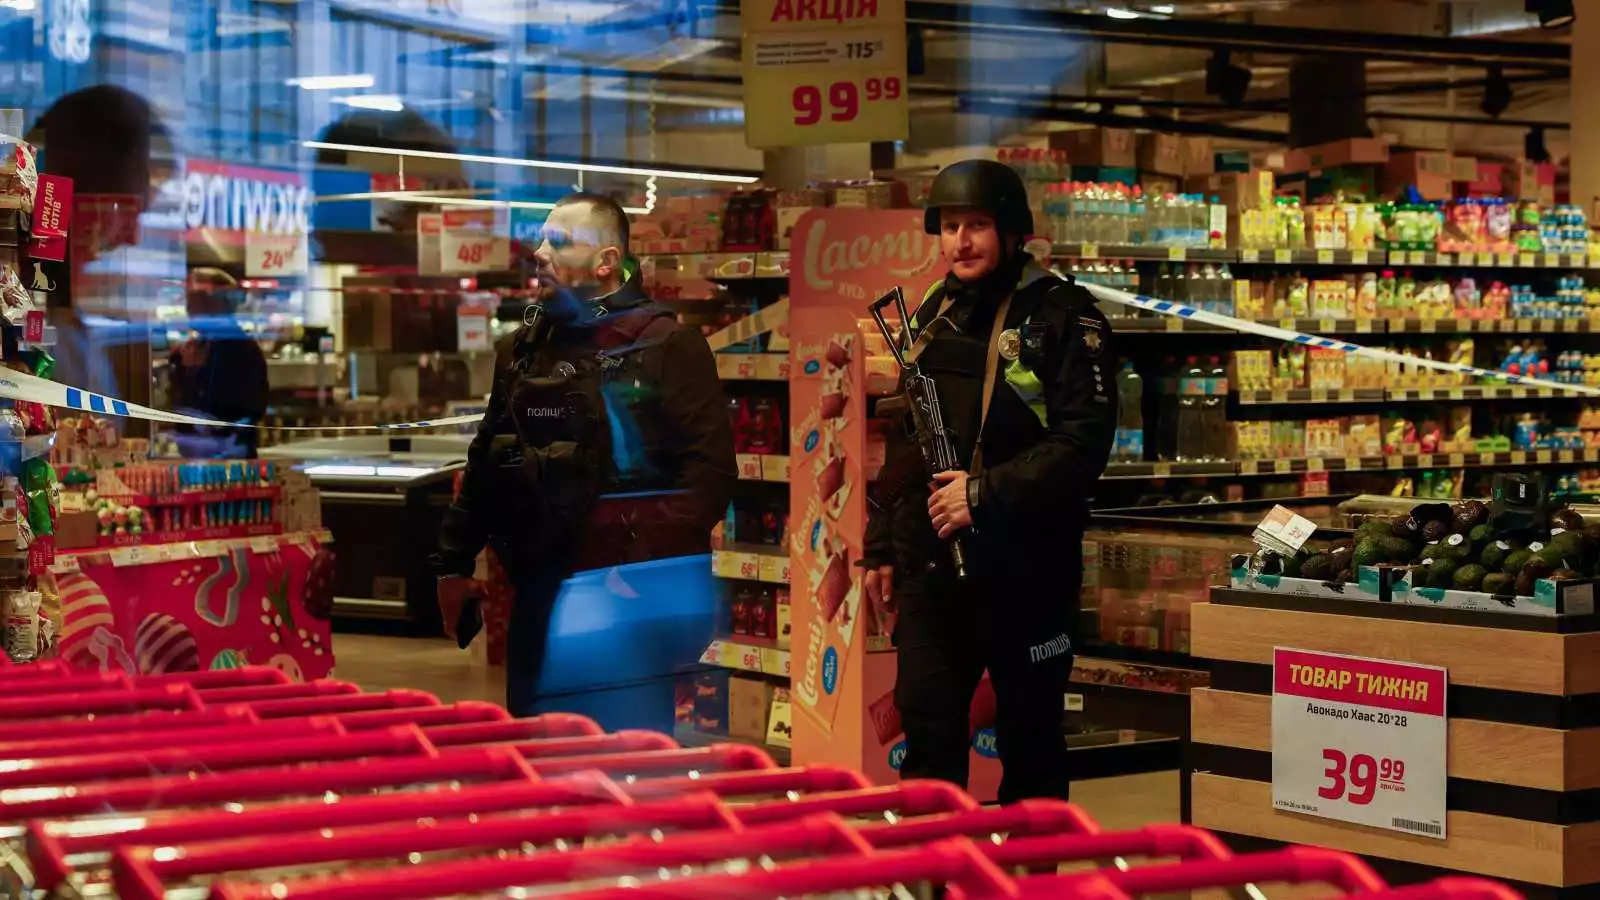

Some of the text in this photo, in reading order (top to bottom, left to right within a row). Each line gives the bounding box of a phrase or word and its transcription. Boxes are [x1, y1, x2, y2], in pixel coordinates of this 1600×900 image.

[770, 0, 878, 24] АКЦІЯ
[792, 76, 901, 126] 99 99
[43, 181, 55, 205] ДЛЯ
[1029, 633, 1072, 663] ПОЛІЦІЯ
[1289, 663, 1429, 702] ТОВАР ТИЖНЯ
[1306, 702, 1349, 719] Авокадо
[1350, 708, 1376, 723] Хаас
[1318, 748, 1405, 805] 39 99
